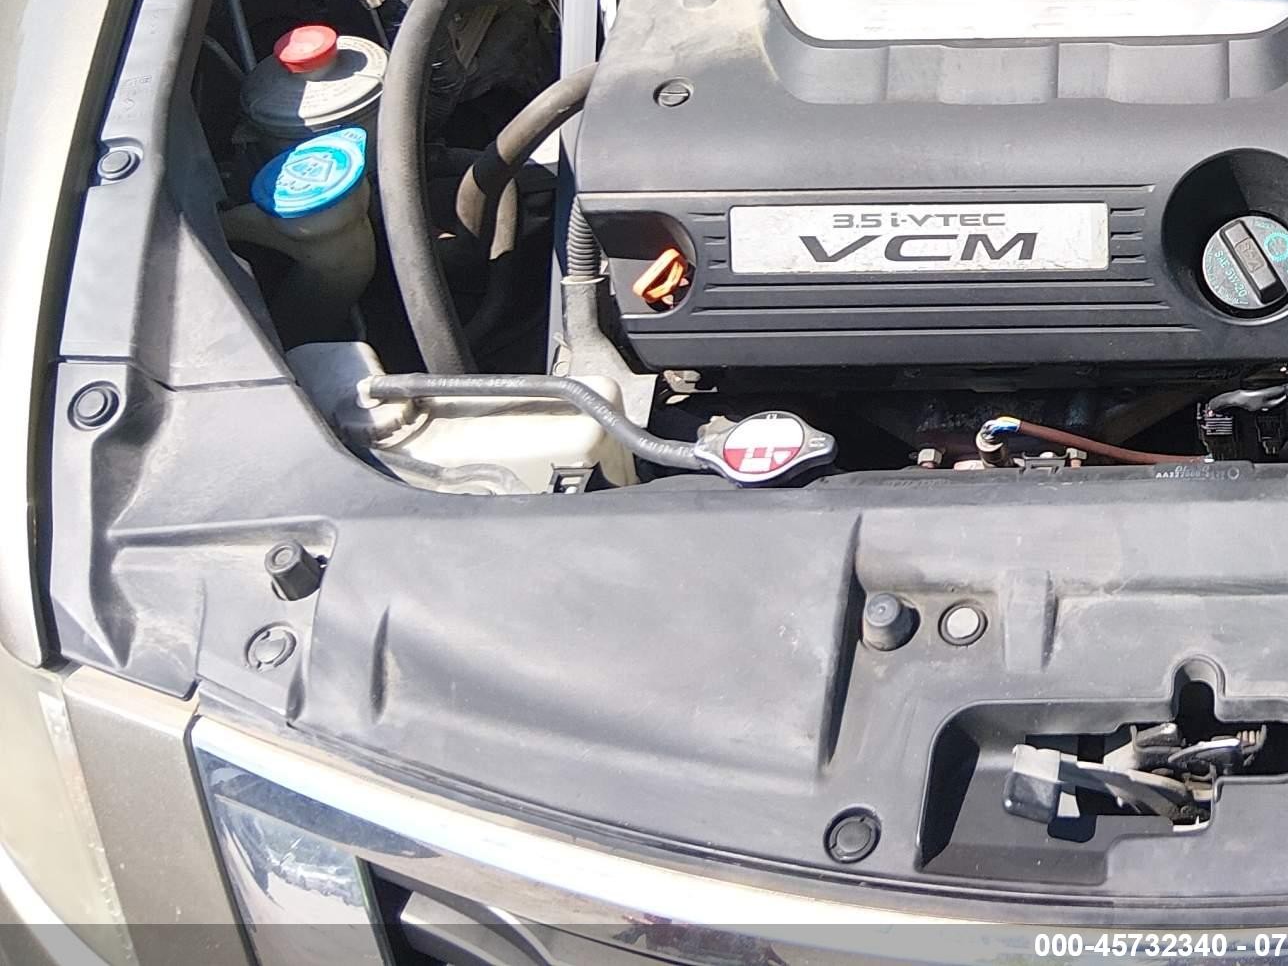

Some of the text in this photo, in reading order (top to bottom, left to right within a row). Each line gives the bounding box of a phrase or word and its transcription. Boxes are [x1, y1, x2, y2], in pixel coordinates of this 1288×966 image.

[833, 212, 1006, 229] 3.5 i-VTEC
[799, 232, 1039, 263] VCM
[1214, 250, 1231, 268] SAE
[1225, 268, 1248, 298] 5W-20
